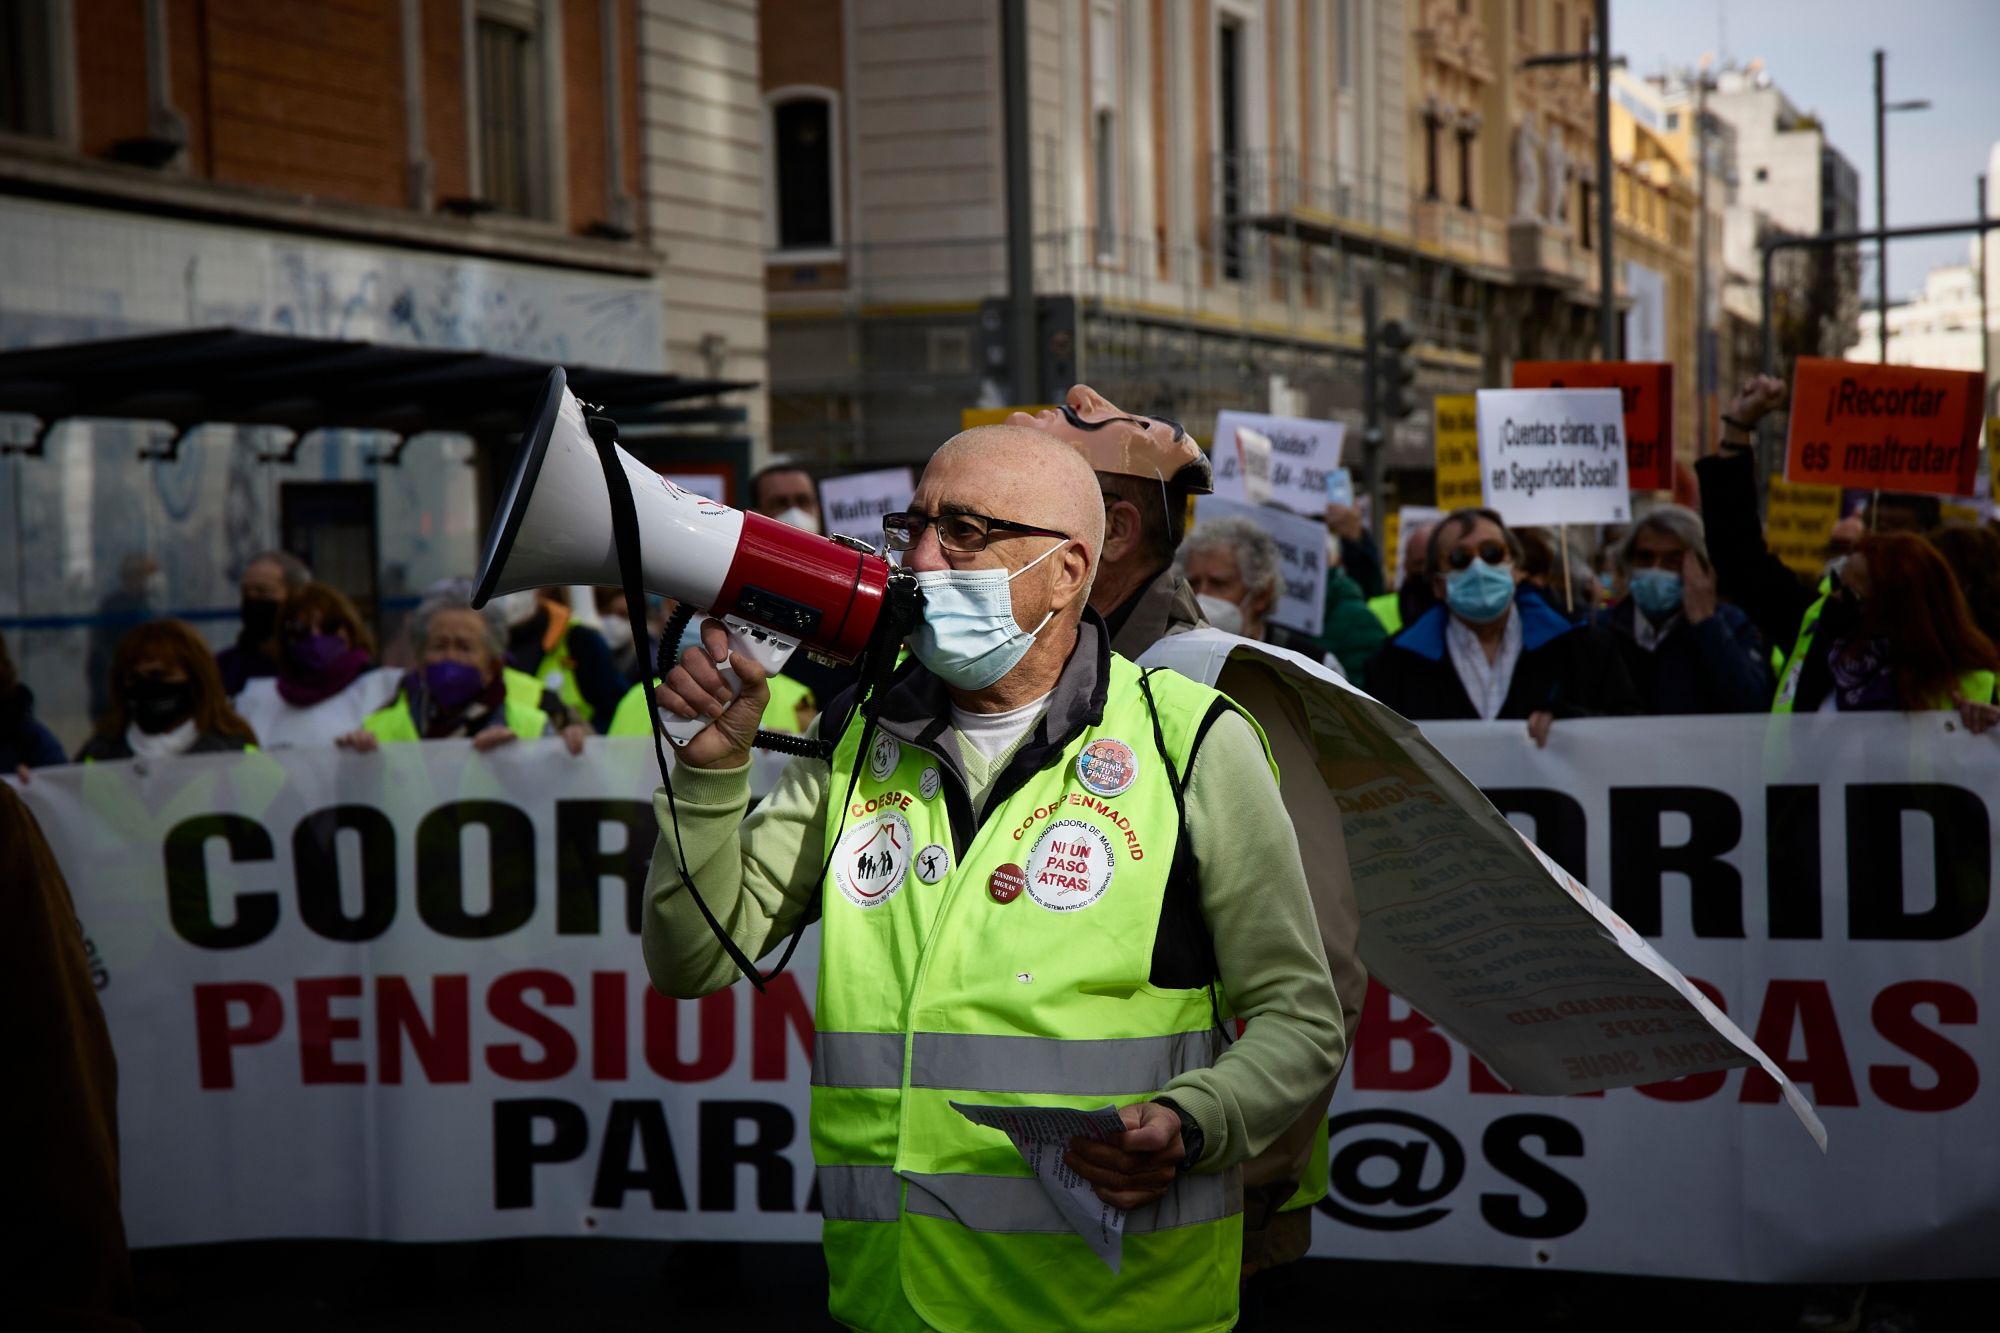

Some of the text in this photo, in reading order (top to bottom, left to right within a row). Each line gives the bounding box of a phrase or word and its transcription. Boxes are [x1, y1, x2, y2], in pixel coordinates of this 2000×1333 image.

[1826, 378, 1946, 426] ¡Recortar
[1500, 418, 1557, 454] ¡Cuentas
[1802, 442, 1830, 471] es
[1844, 435, 1967, 479] maltratar!
[1492, 468, 1507, 490] en
[1511, 460, 1577, 497] Seguridad
[1101, 767, 1110, 775] TU
[851, 791, 913, 817] COESPE
[1013, 793, 1144, 861] COORPENMADRID
[1031, 819, 1115, 868] COORDINADORA DE MADRID
[1051, 840, 1092, 859] NI UN
[991, 870, 1025, 886] PENSIONES
[993, 879, 1016, 892] DIGNAS
[1034, 896, 1043, 905] DEL
[1044, 902, 1065, 911] SISTEMA
[1095, 872, 1112, 899] PENSIONES
[1037, 871, 1088, 892] ATRAS
[493, 1099, 823, 1213] PAR
